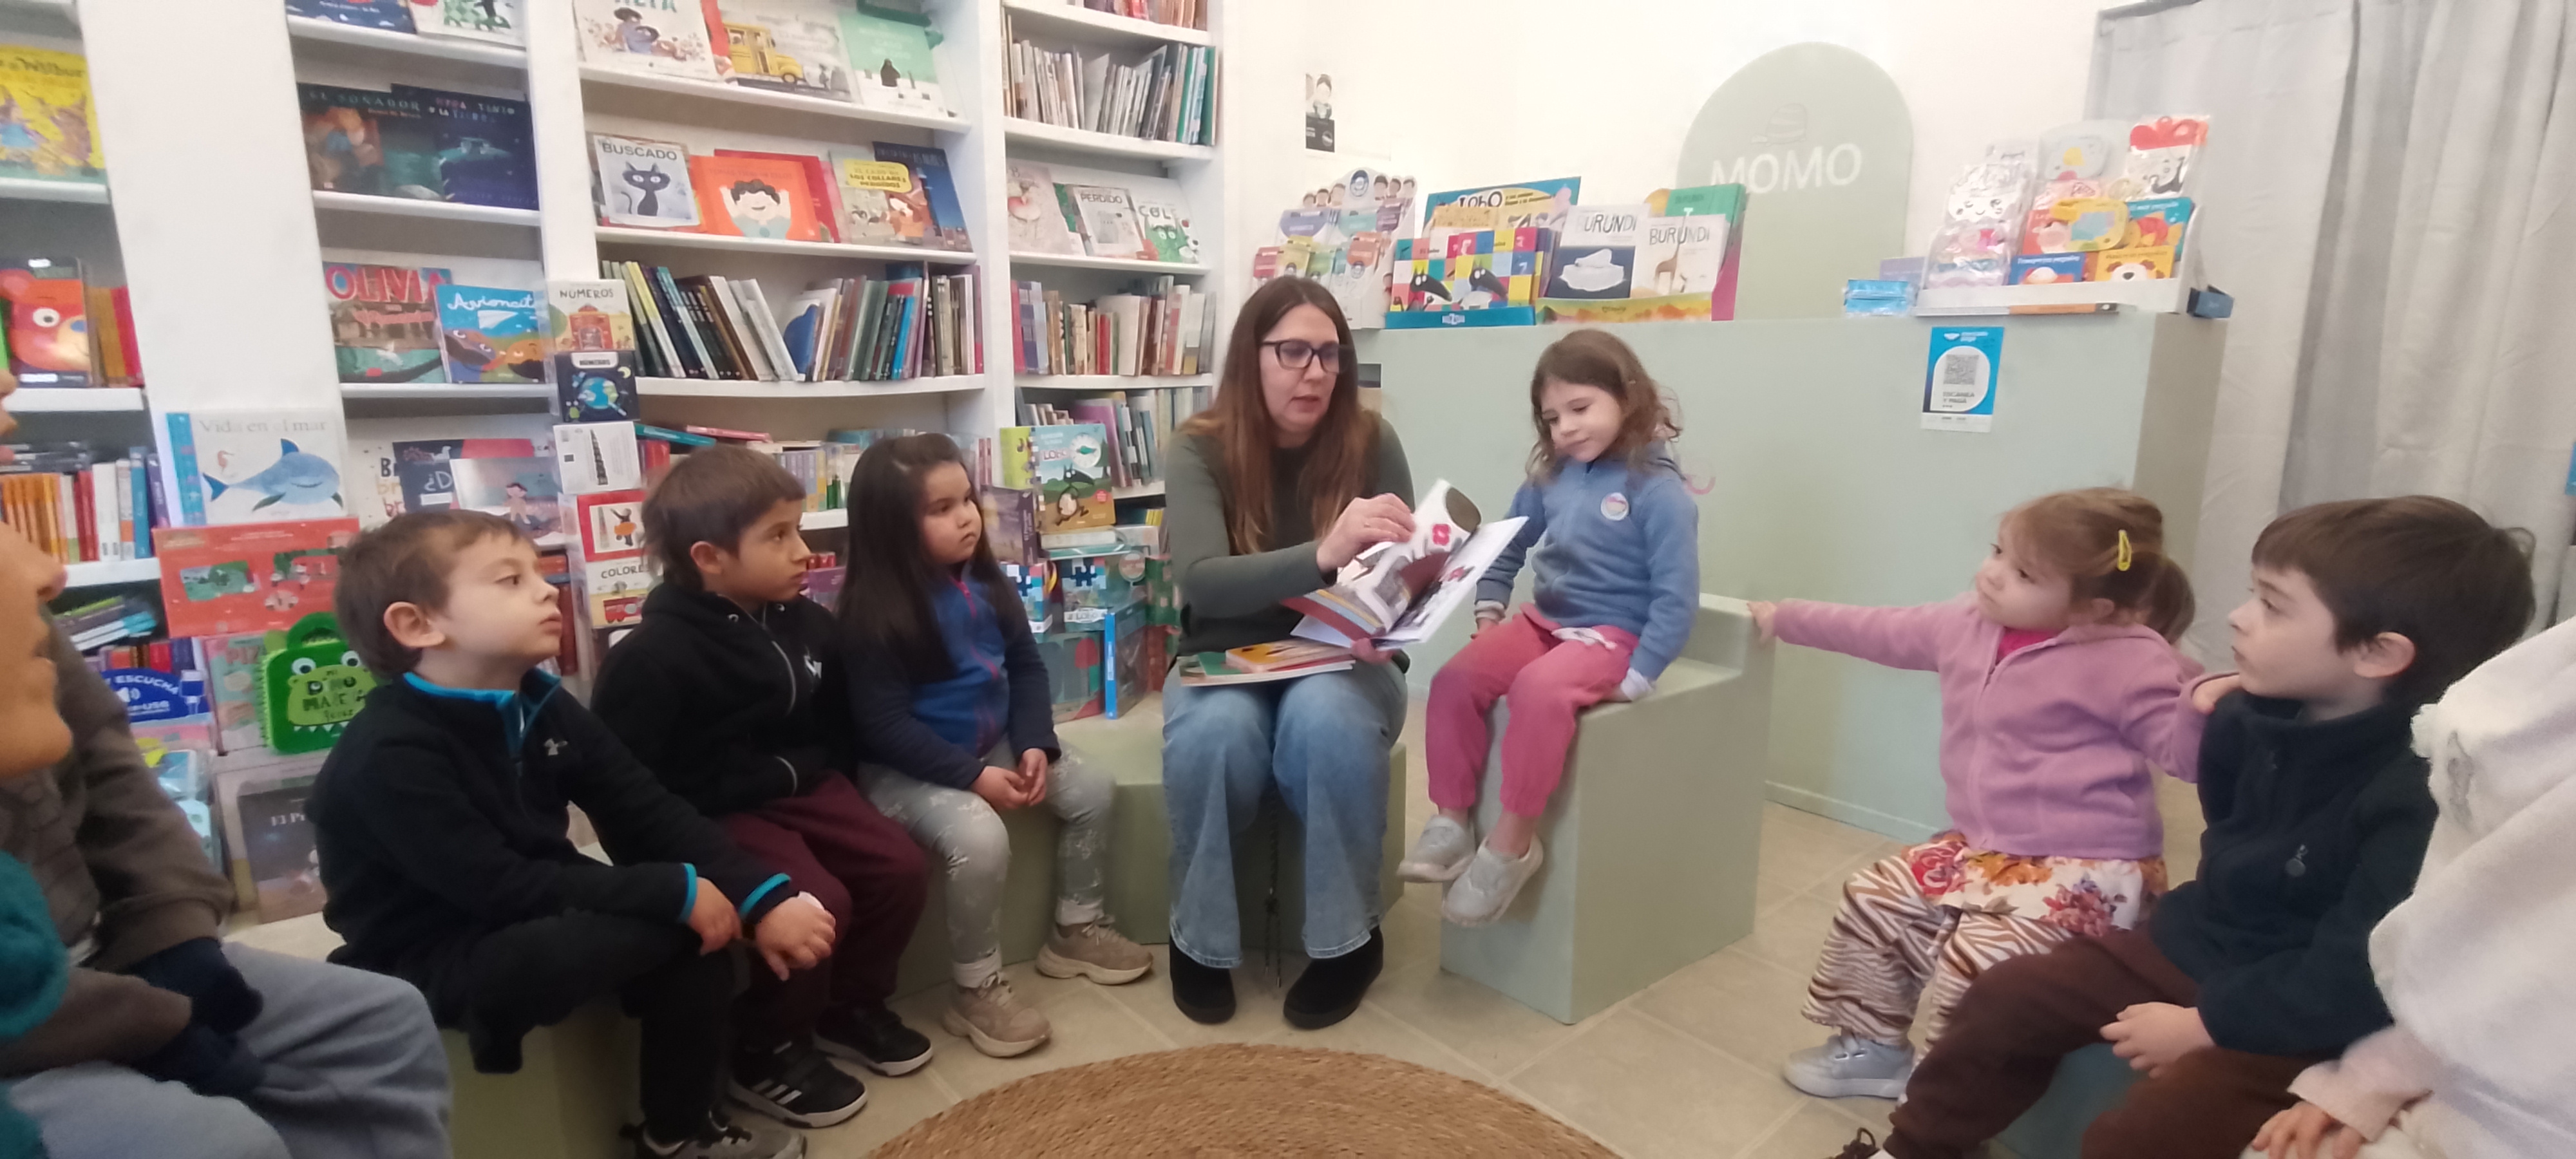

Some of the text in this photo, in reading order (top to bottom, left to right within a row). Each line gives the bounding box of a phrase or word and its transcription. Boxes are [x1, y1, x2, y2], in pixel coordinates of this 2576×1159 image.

[602, 142, 677, 160] BUSCADO
[1710, 143, 1862, 194] MOMO
[1081, 193, 1122, 204] PERDIDO
[1649, 227, 1710, 245] BURUNDI
[447, 292, 535, 310] Avioncit
[199, 420, 243, 433] Vida
[247, 422, 269, 432] en
[292, 420, 328, 431] mar
[115, 675, 178, 695] ESCUCHA
